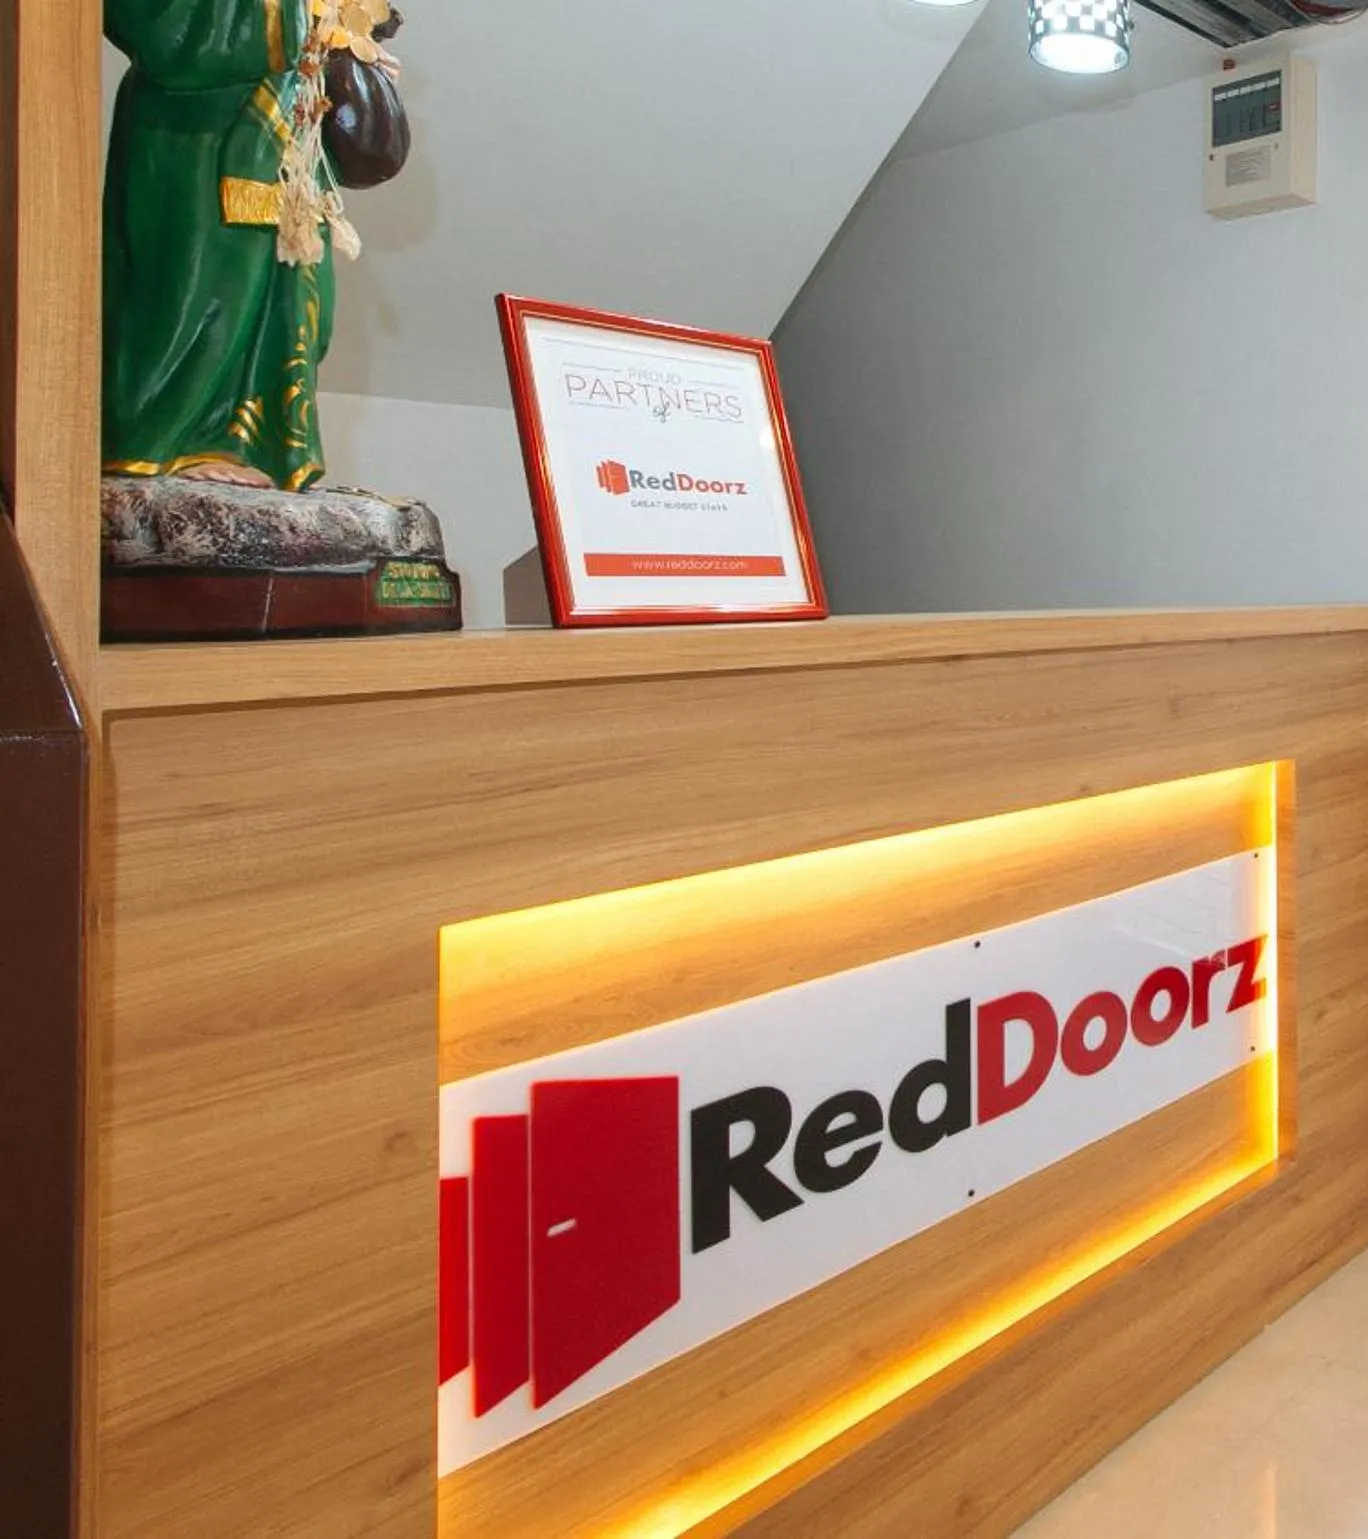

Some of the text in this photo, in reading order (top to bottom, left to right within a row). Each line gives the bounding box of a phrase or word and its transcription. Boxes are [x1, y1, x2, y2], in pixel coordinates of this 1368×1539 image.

[627, 367, 682, 386] PROUD
[565, 373, 743, 419] PARTNERS
[652, 400, 671, 423] of
[628, 470, 748, 496] RedDoorz
[631, 559, 748, 570] www.reddoorz.com
[690, 933, 1268, 1255] RedDoorz
